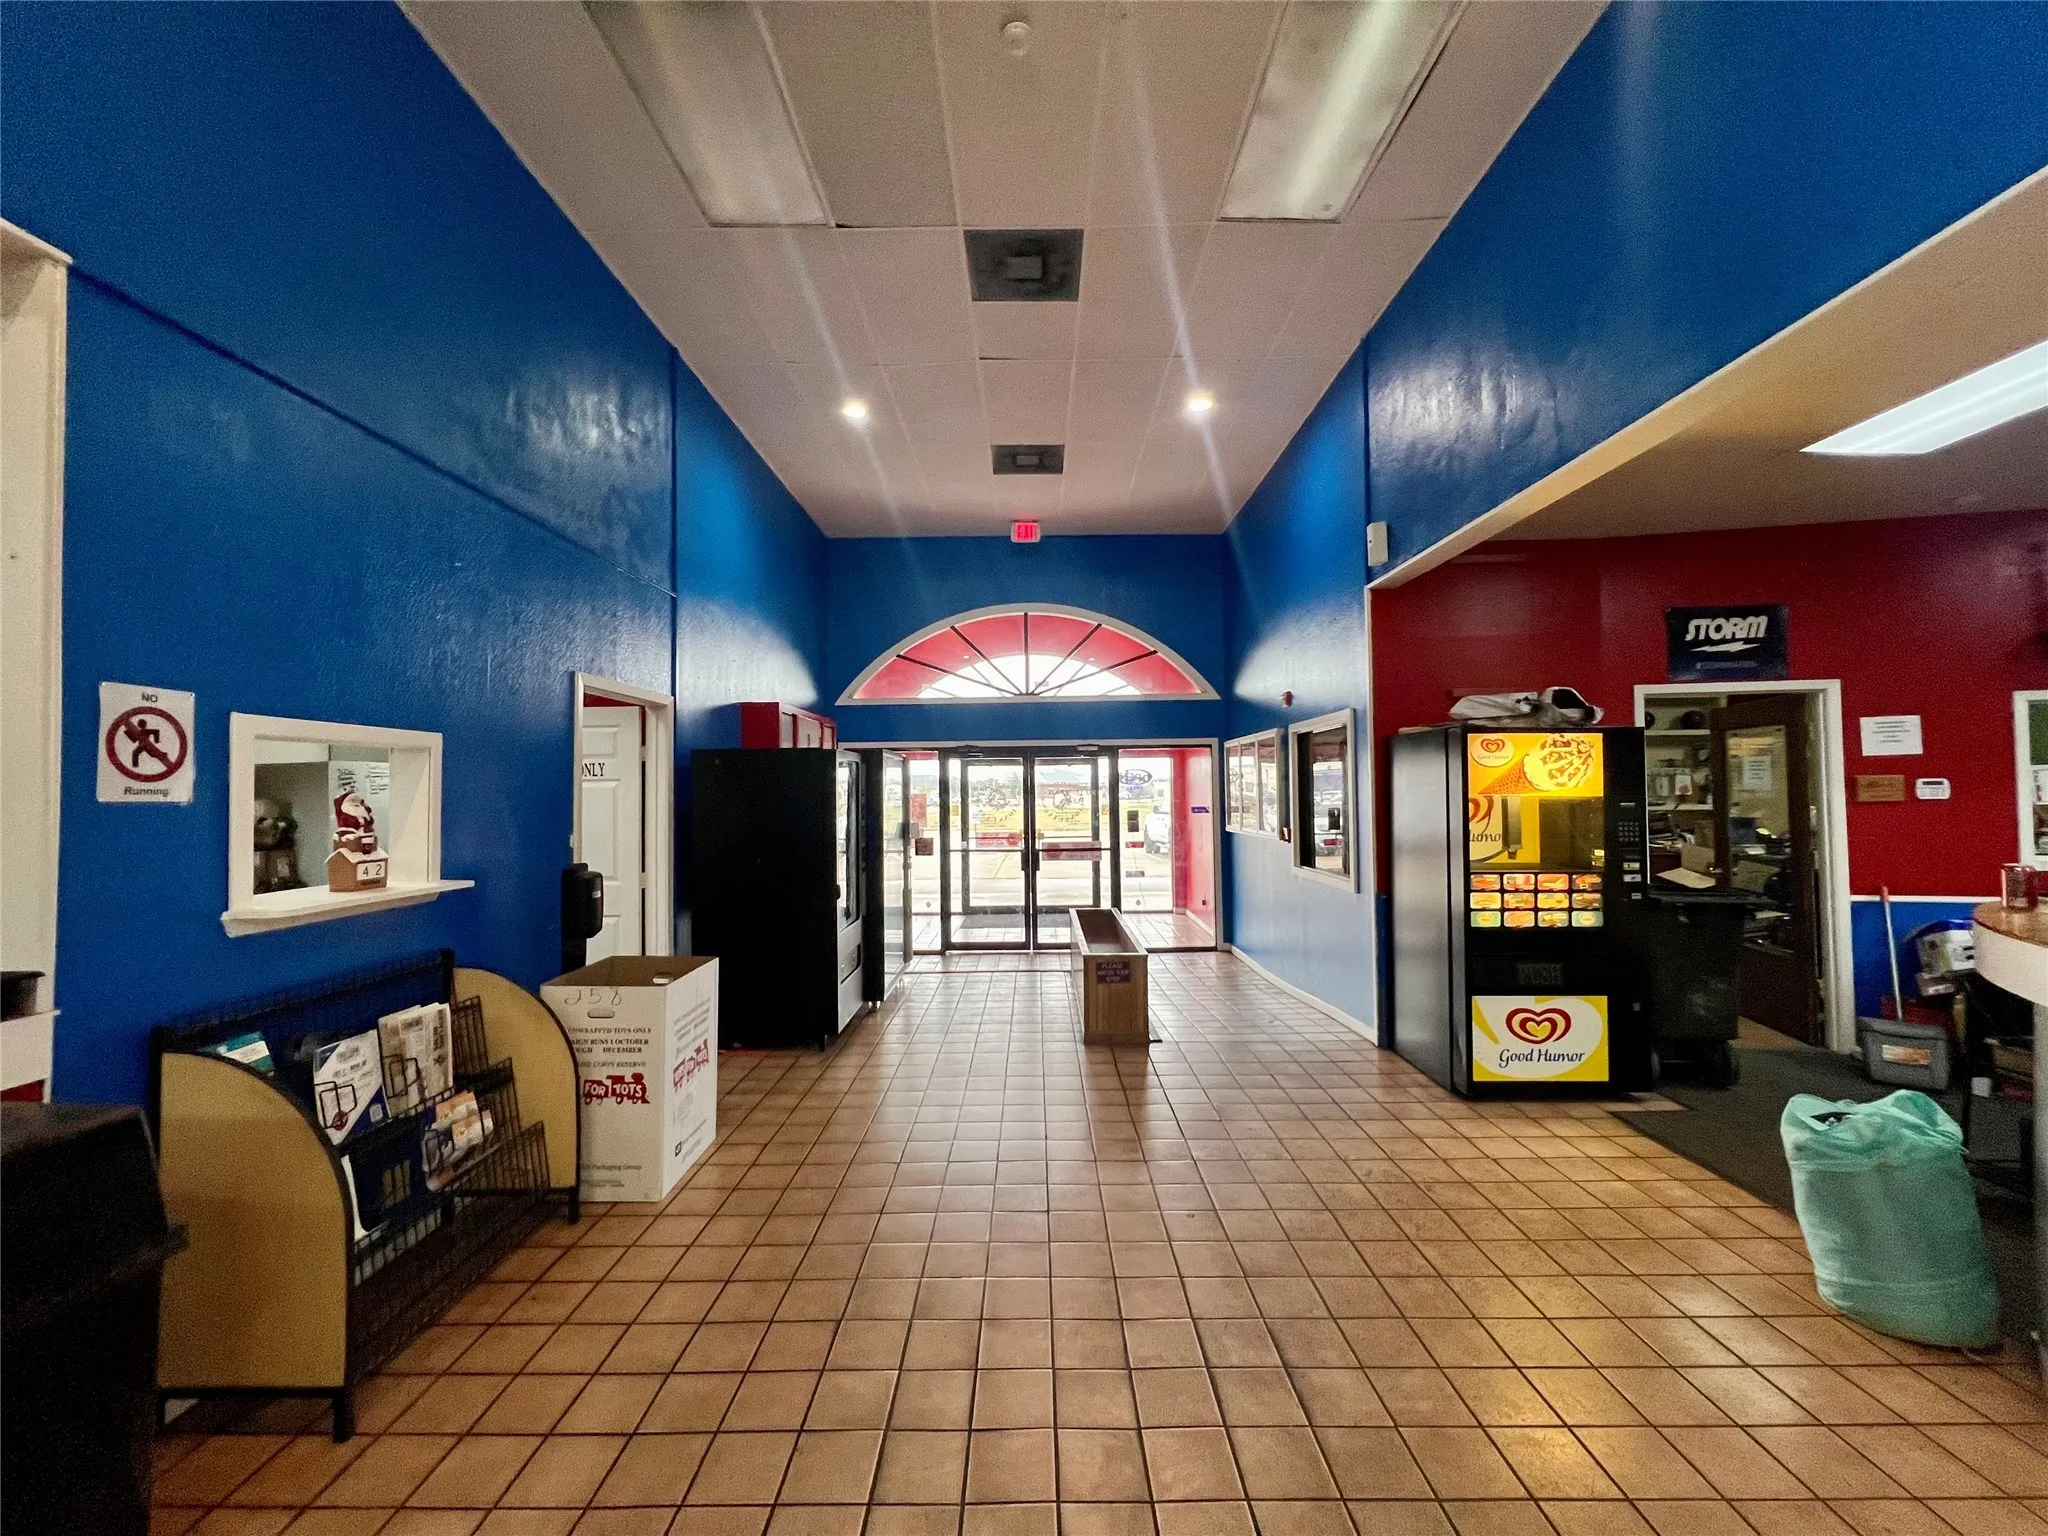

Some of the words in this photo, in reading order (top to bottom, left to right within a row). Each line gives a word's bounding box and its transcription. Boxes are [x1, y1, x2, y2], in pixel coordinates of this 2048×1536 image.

[1685, 615, 1768, 641] STORM
[141, 693, 158, 703] NO
[124, 786, 169, 797] Running
[1470, 829, 1501, 842] umo
[1499, 1048, 1534, 1069] Good
[1537, 1048, 1585, 1063] Humor
[584, 1082, 606, 1096] FOR
[613, 1083, 642, 1097] TOTS
